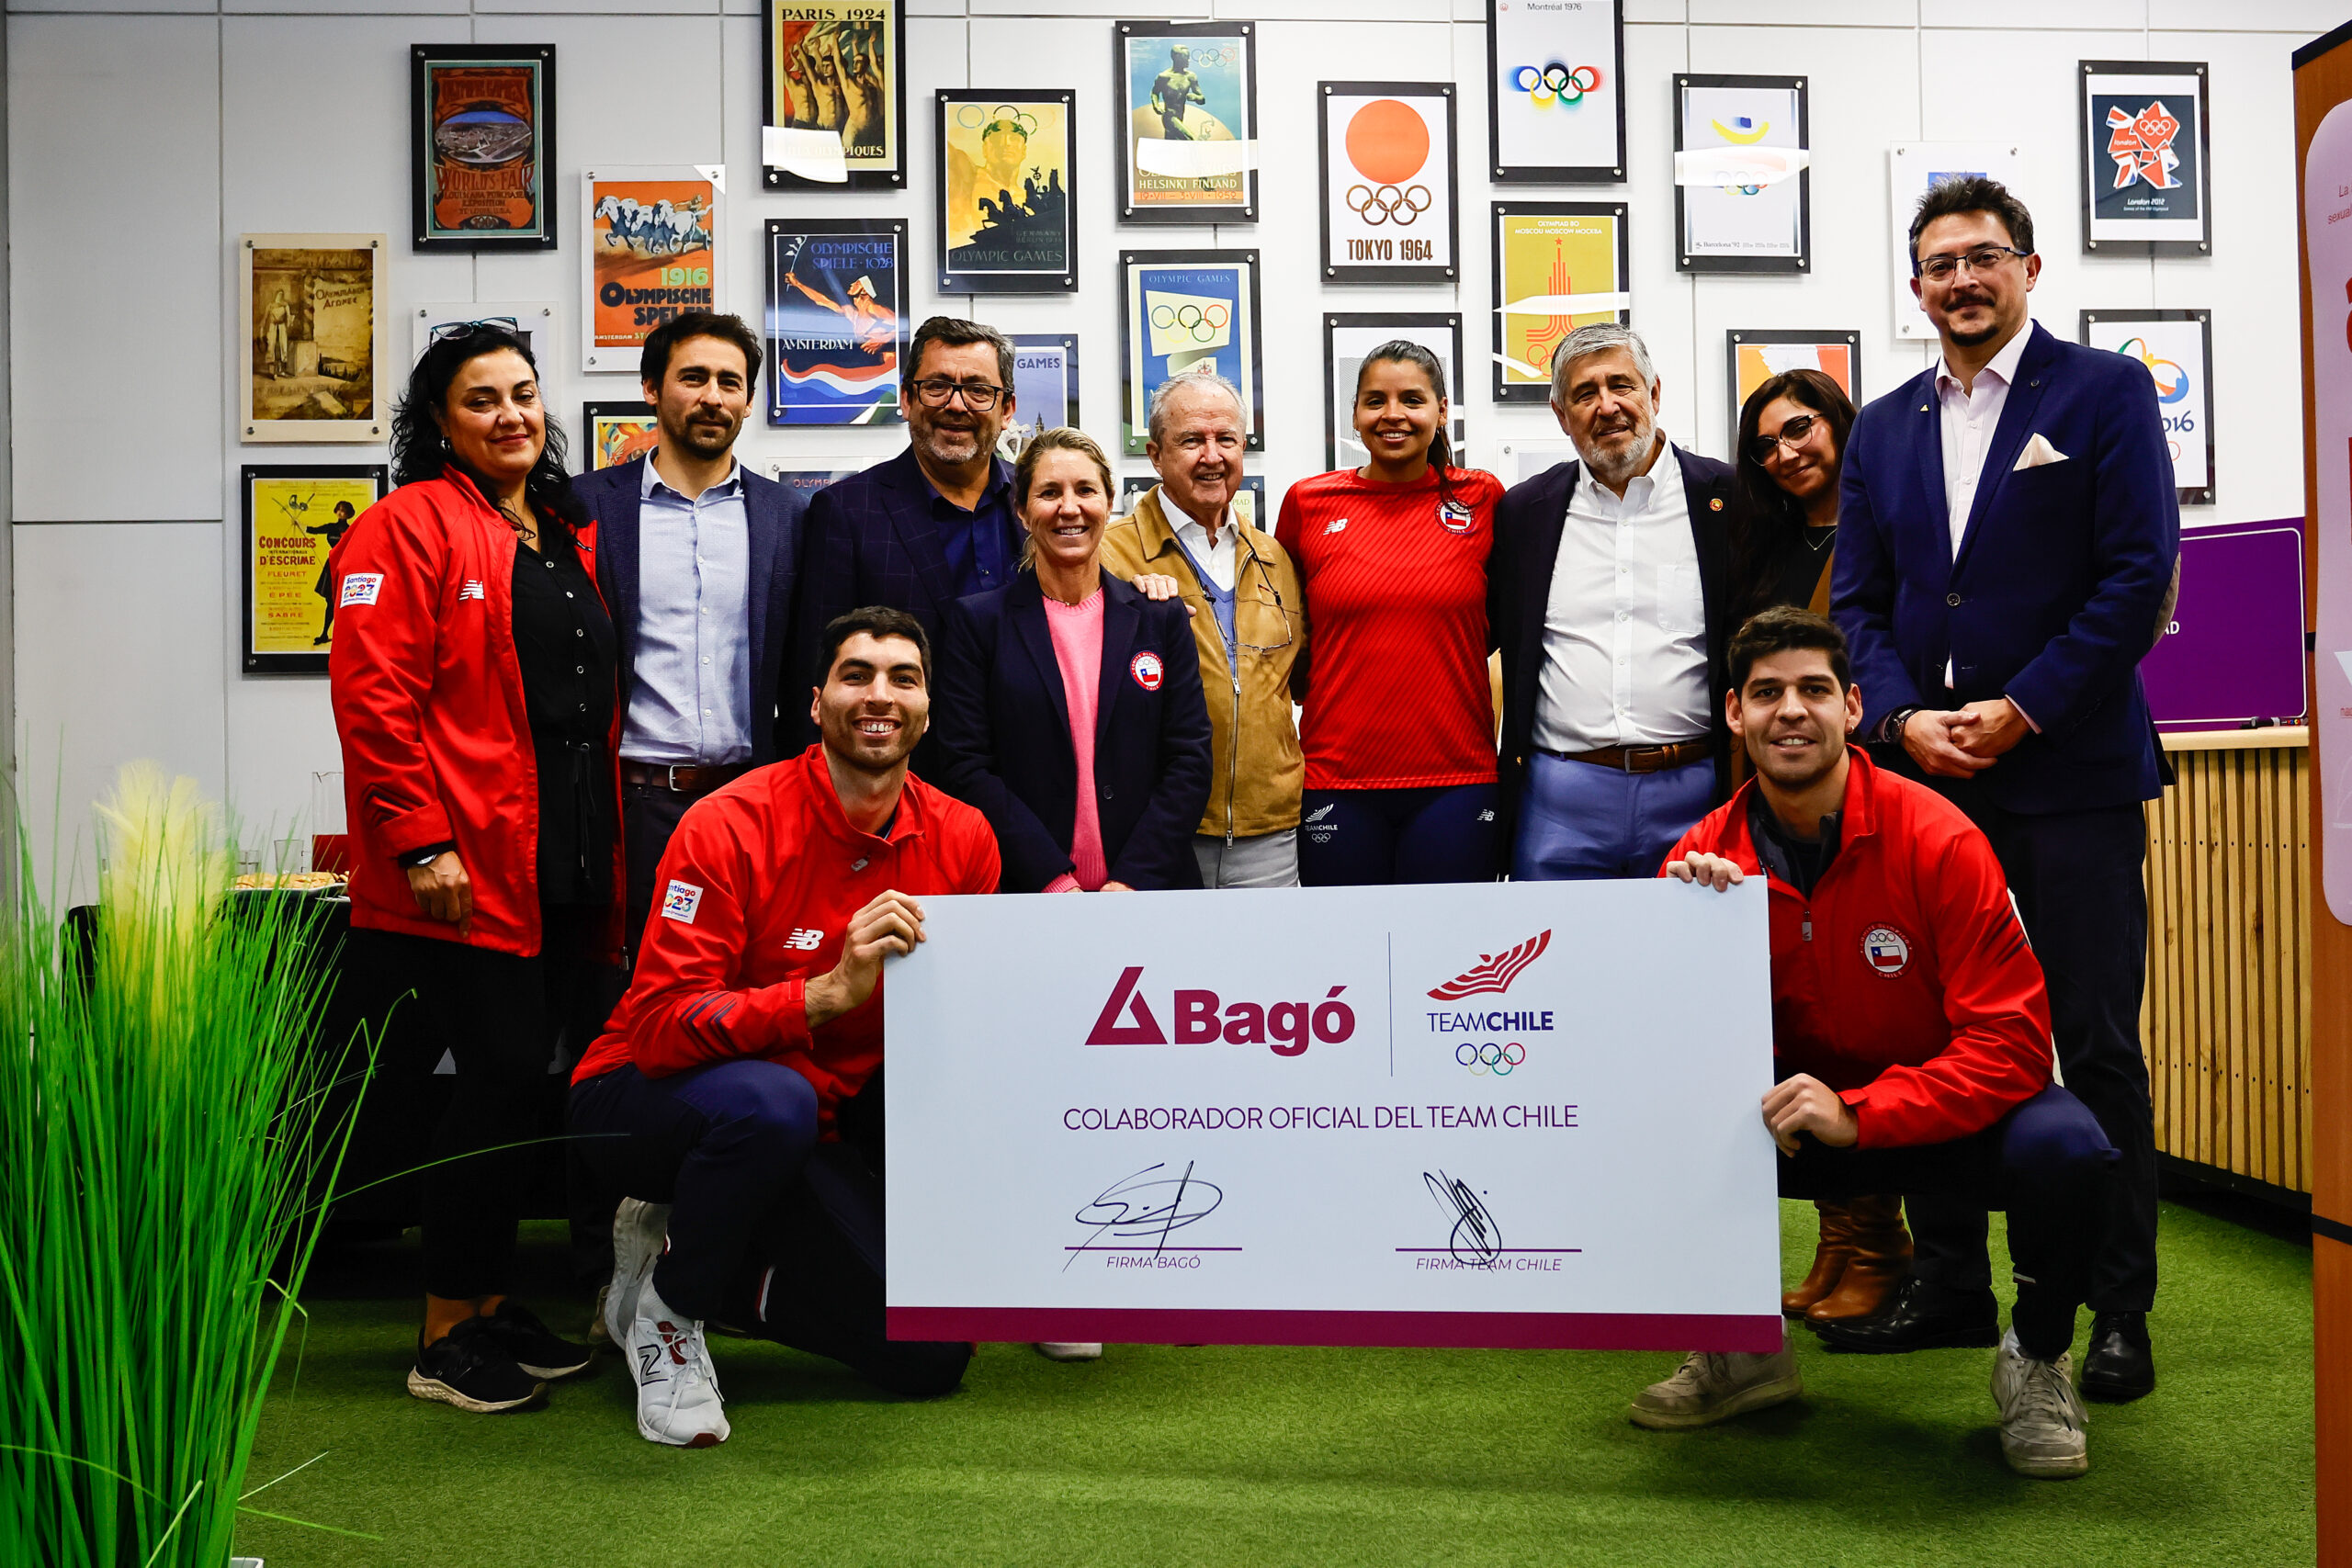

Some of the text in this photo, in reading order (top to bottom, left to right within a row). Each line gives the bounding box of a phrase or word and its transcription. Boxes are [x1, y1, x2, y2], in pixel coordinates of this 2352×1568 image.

[1526, 3, 1582, 11] Montréal 1976
[782, 8, 886, 20] PARIS 1924
[1139, 179, 1238, 189] HELSINKI FINLAND
[2127, 197, 2165, 206] London 2012
[810, 243, 893, 254] OLYMPISCHE
[1347, 239, 1433, 261] TOKYO 1964
[951, 250, 1063, 262] OLYMPIC GAMES
[813, 257, 857, 269] SPIELE
[661, 267, 708, 287] 1916
[1197, 275, 1231, 283] GAMES
[600, 281, 712, 308] OLYMPISCHE
[782, 338, 854, 350] AMSTERDAM
[1016, 357, 1060, 369] GAMES
[258, 536, 317, 549] CONCOURS
[259, 555, 316, 567] D'ESCRIME
[346, 576, 377, 584] Santiago
[1173, 985, 1356, 1057] Bagó
[1063, 1104, 1579, 1131] COLABORADOR OFICIAL DEL TEAM CHILE
[1106, 1254, 1201, 1269] FIRMA BAGÓ
[1416, 1258, 1563, 1271] FIRMA TEAM CHILE
